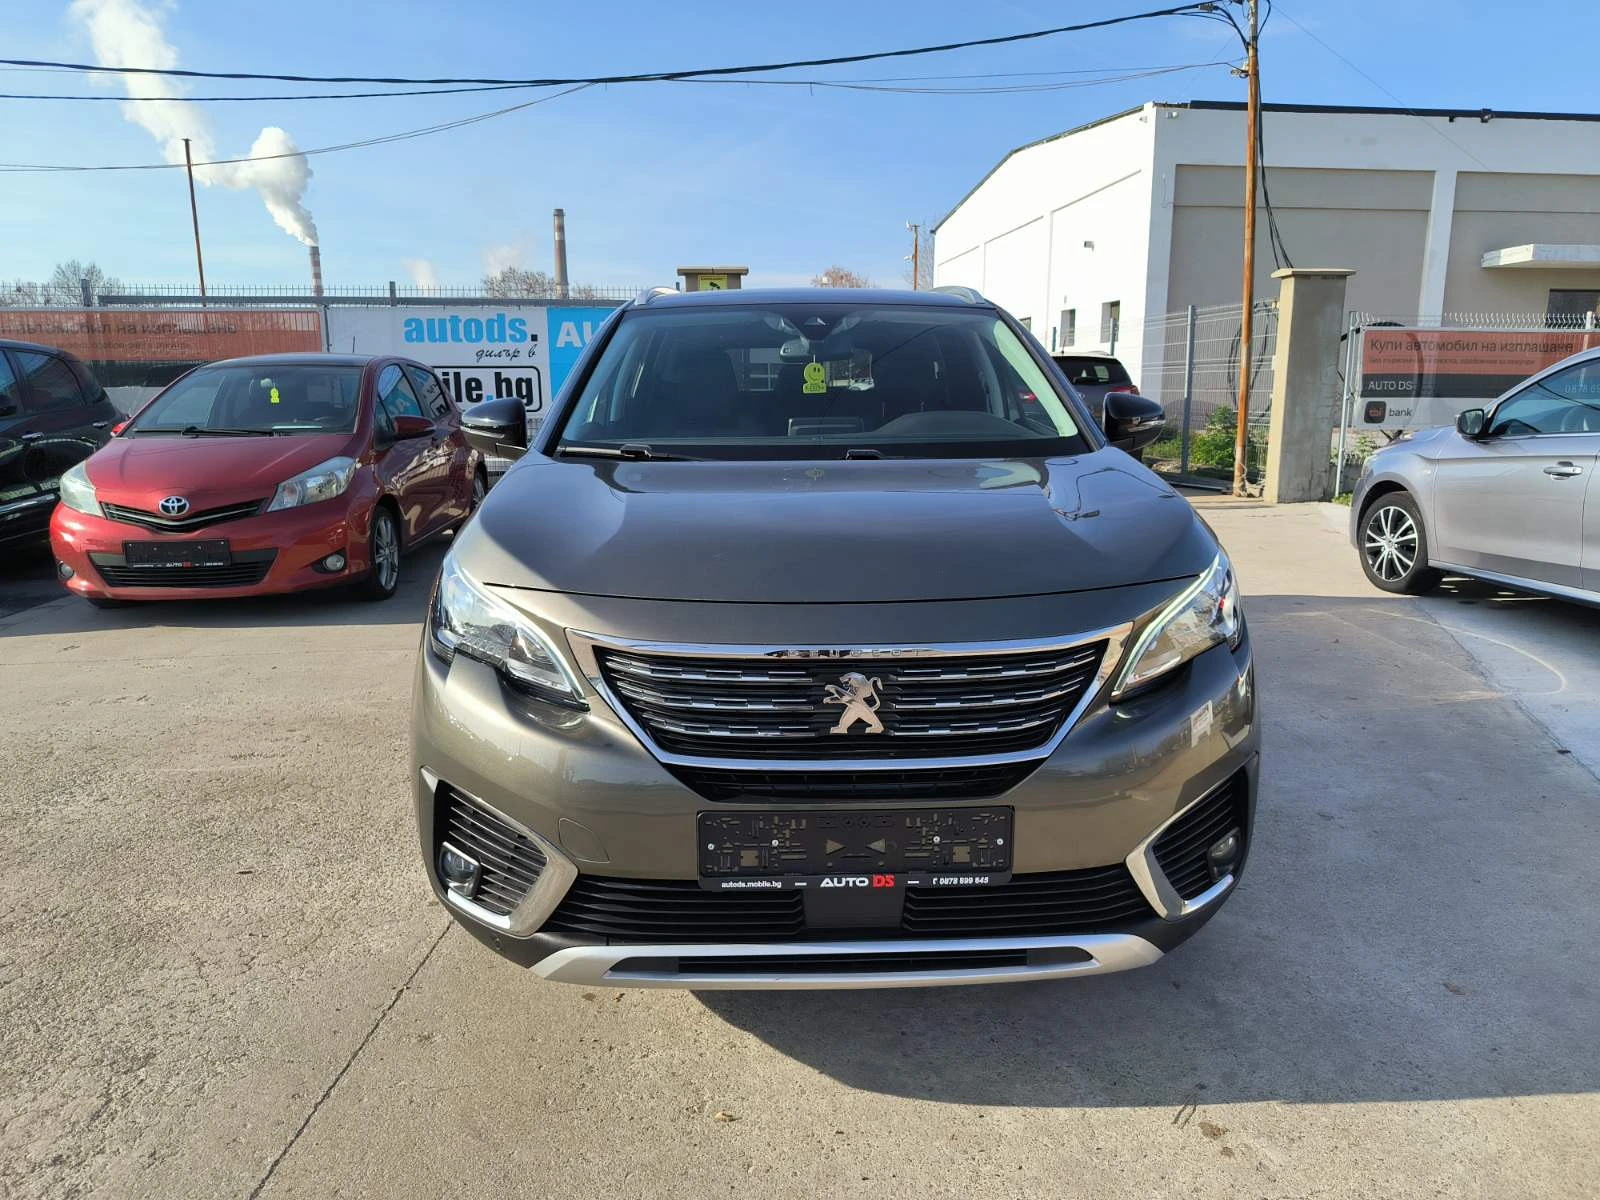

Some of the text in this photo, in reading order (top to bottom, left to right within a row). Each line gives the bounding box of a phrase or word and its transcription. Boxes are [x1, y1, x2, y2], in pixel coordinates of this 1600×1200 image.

[404, 313, 538, 343] autods.
[475, 344, 538, 363] дилър в
[1370, 339, 1402, 354] Купи
[1406, 340, 1478, 352] автомобил
[1481, 342, 1497, 352] на
[441, 371, 534, 407] ile.bg
[1368, 380, 1413, 391] AUTO DS
[1389, 407, 1412, 417] bank
[721, 880, 782, 889] autods.mobile.bg
[820, 877, 869, 888] AUTO
[873, 874, 895, 888] DS
